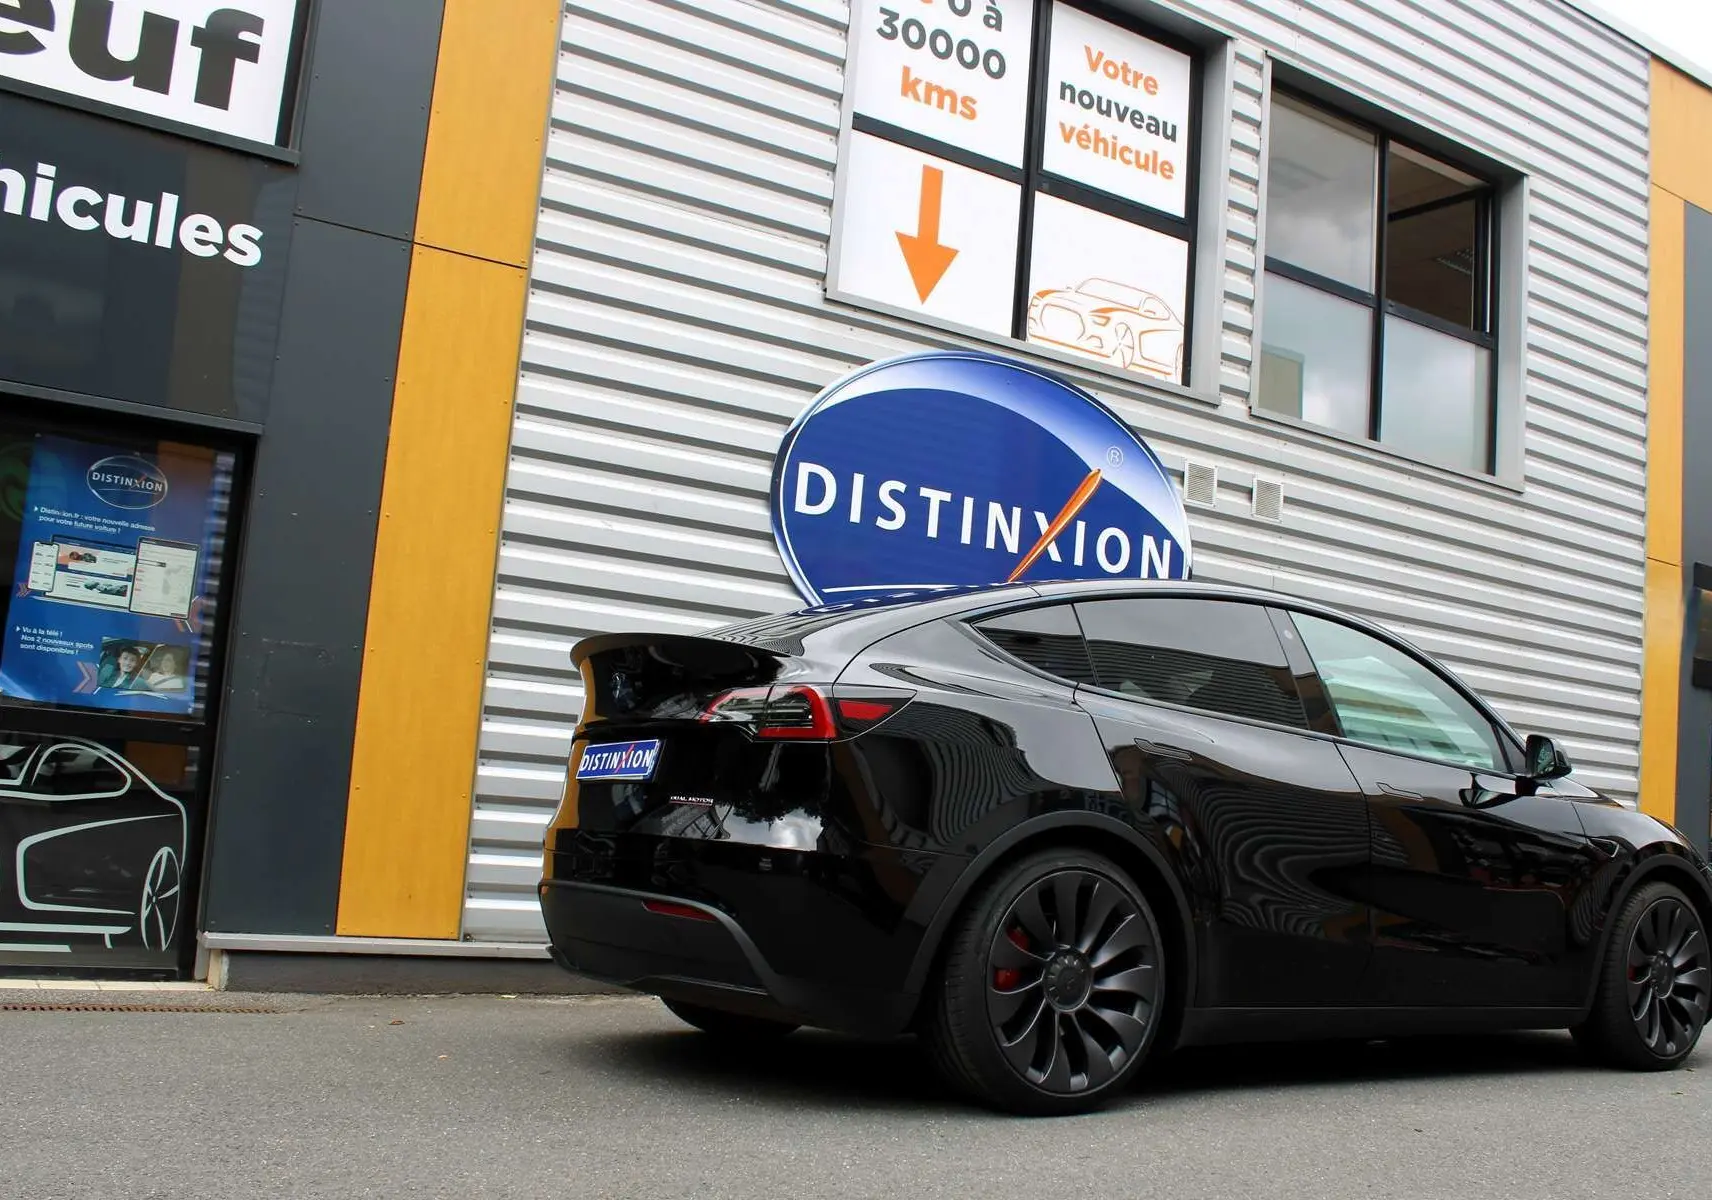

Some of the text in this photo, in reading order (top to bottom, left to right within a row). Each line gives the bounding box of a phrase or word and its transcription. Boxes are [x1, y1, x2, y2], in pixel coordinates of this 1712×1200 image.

[876, 6, 1006, 80] 30000
[1084, 45, 1158, 96] Votre
[901, 65, 978, 120] kms
[1060, 80, 1177, 143] nouveau
[1059, 120, 1175, 180] véhicule
[92, 471, 163, 492] DISTINXION
[39, 515, 55, 523] pour
[56, 517, 73, 526] votre
[73, 520, 93, 530] future
[84, 514, 101, 523] votre
[102, 517, 129, 528] nouvelle
[794, 461, 1172, 580] DISTINXION
[20, 643, 36, 651] sont
[21, 634, 35, 642] Nos
[75, 641, 95, 650] spots
[579, 747, 655, 772] DISTINXION
